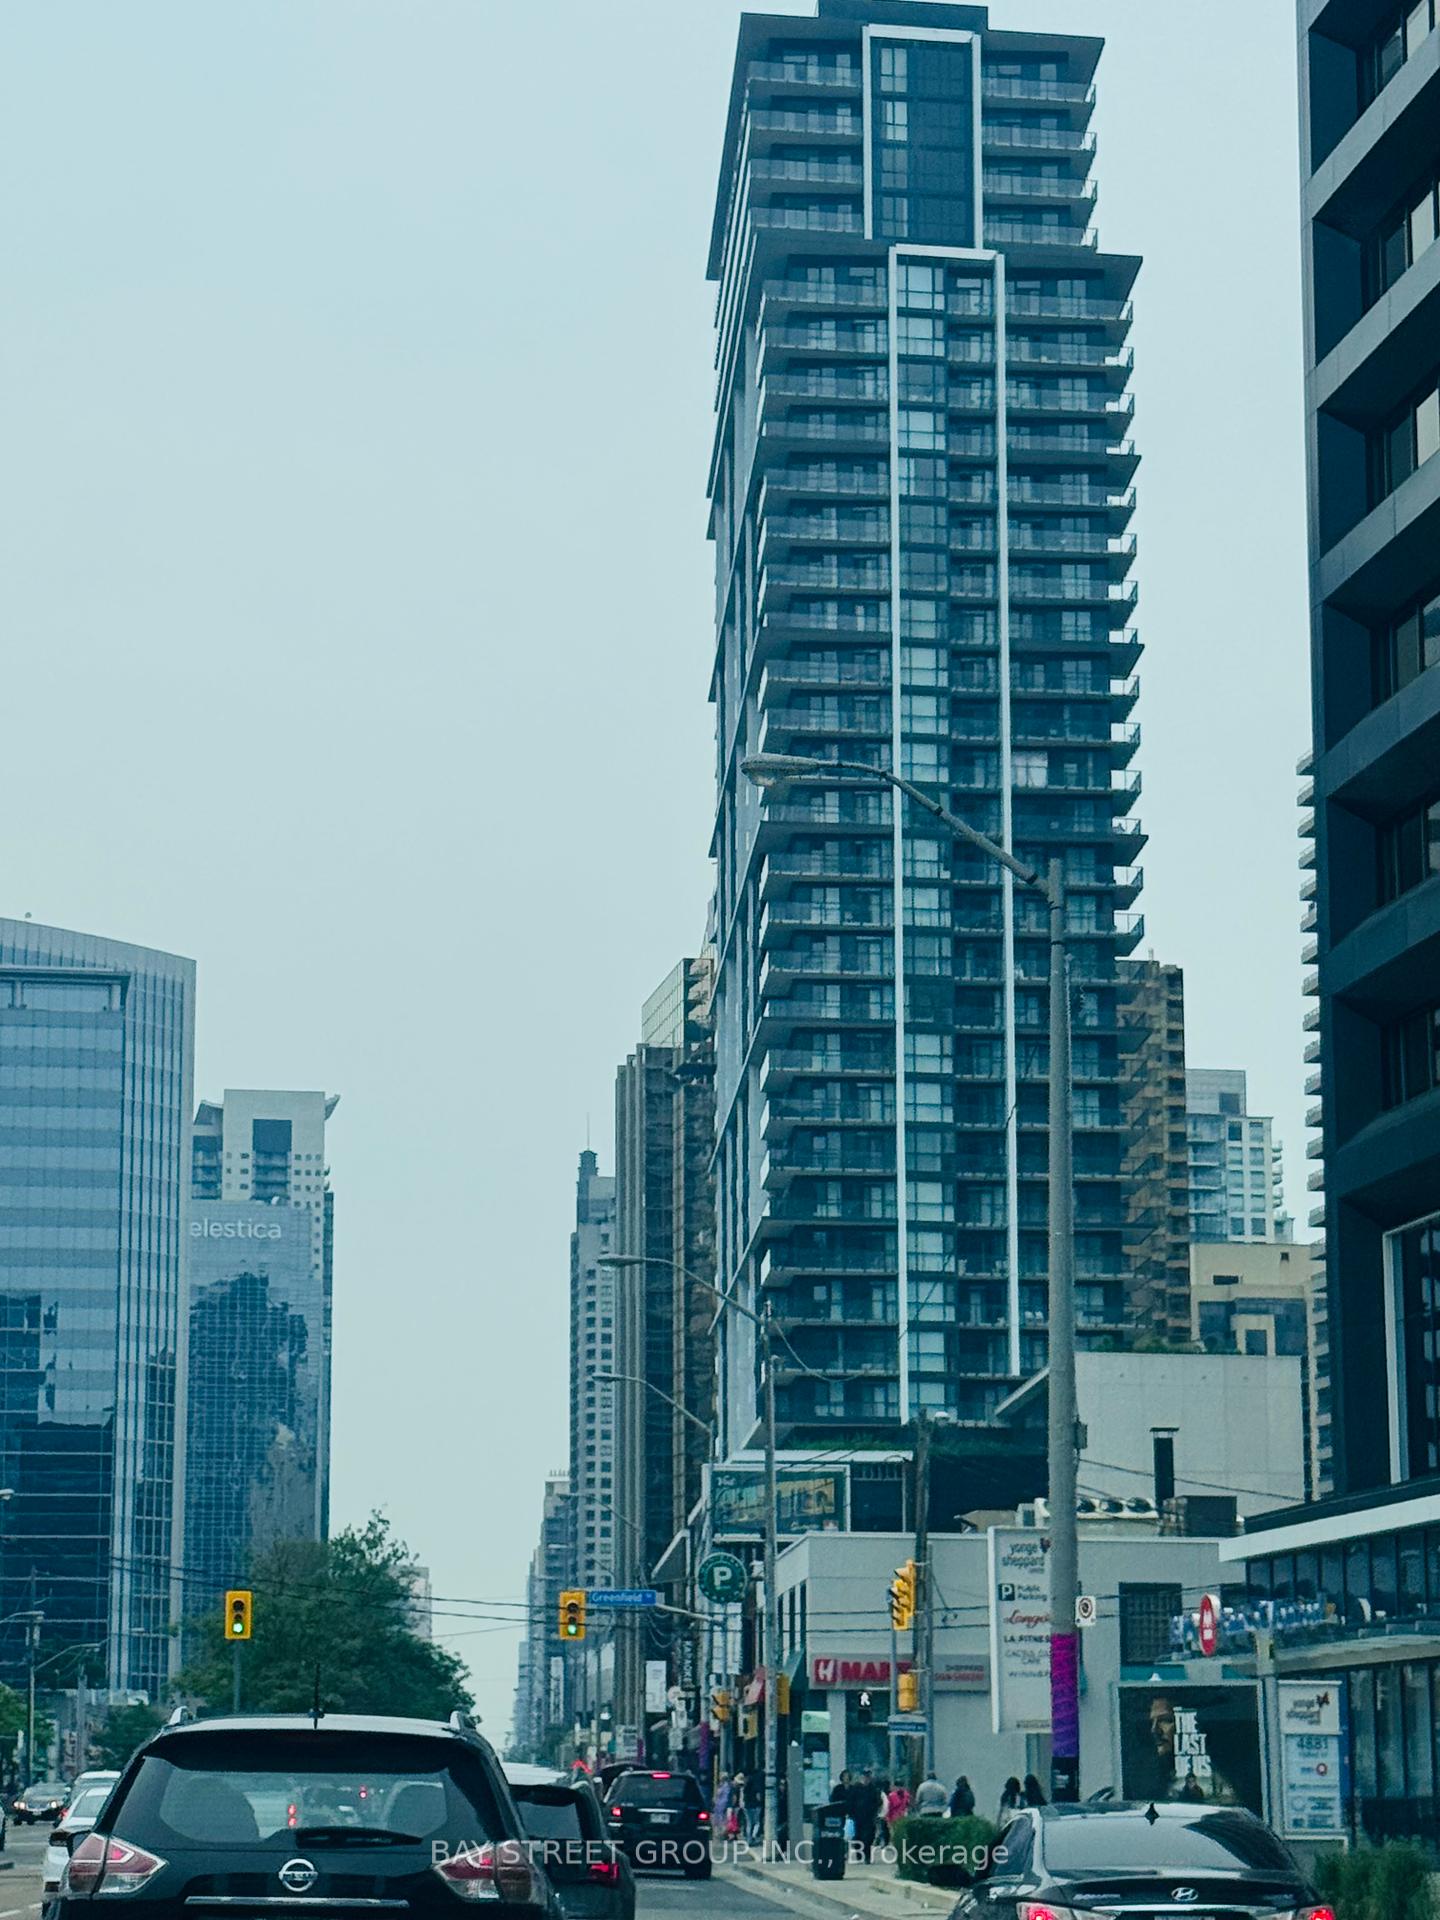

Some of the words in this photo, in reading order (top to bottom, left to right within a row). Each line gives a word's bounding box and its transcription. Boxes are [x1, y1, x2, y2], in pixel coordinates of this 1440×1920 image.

[190, 1217, 282, 1239] elestica
[592, 1592, 642, 1603] Greenfield
[818, 1659, 835, 1682] H
[1173, 1710, 1199, 1734] THE
[1173, 1733, 1208, 1755] LAST
[1296, 1736, 1329, 1750] 4881
[1192, 1755, 1213, 1777] US
